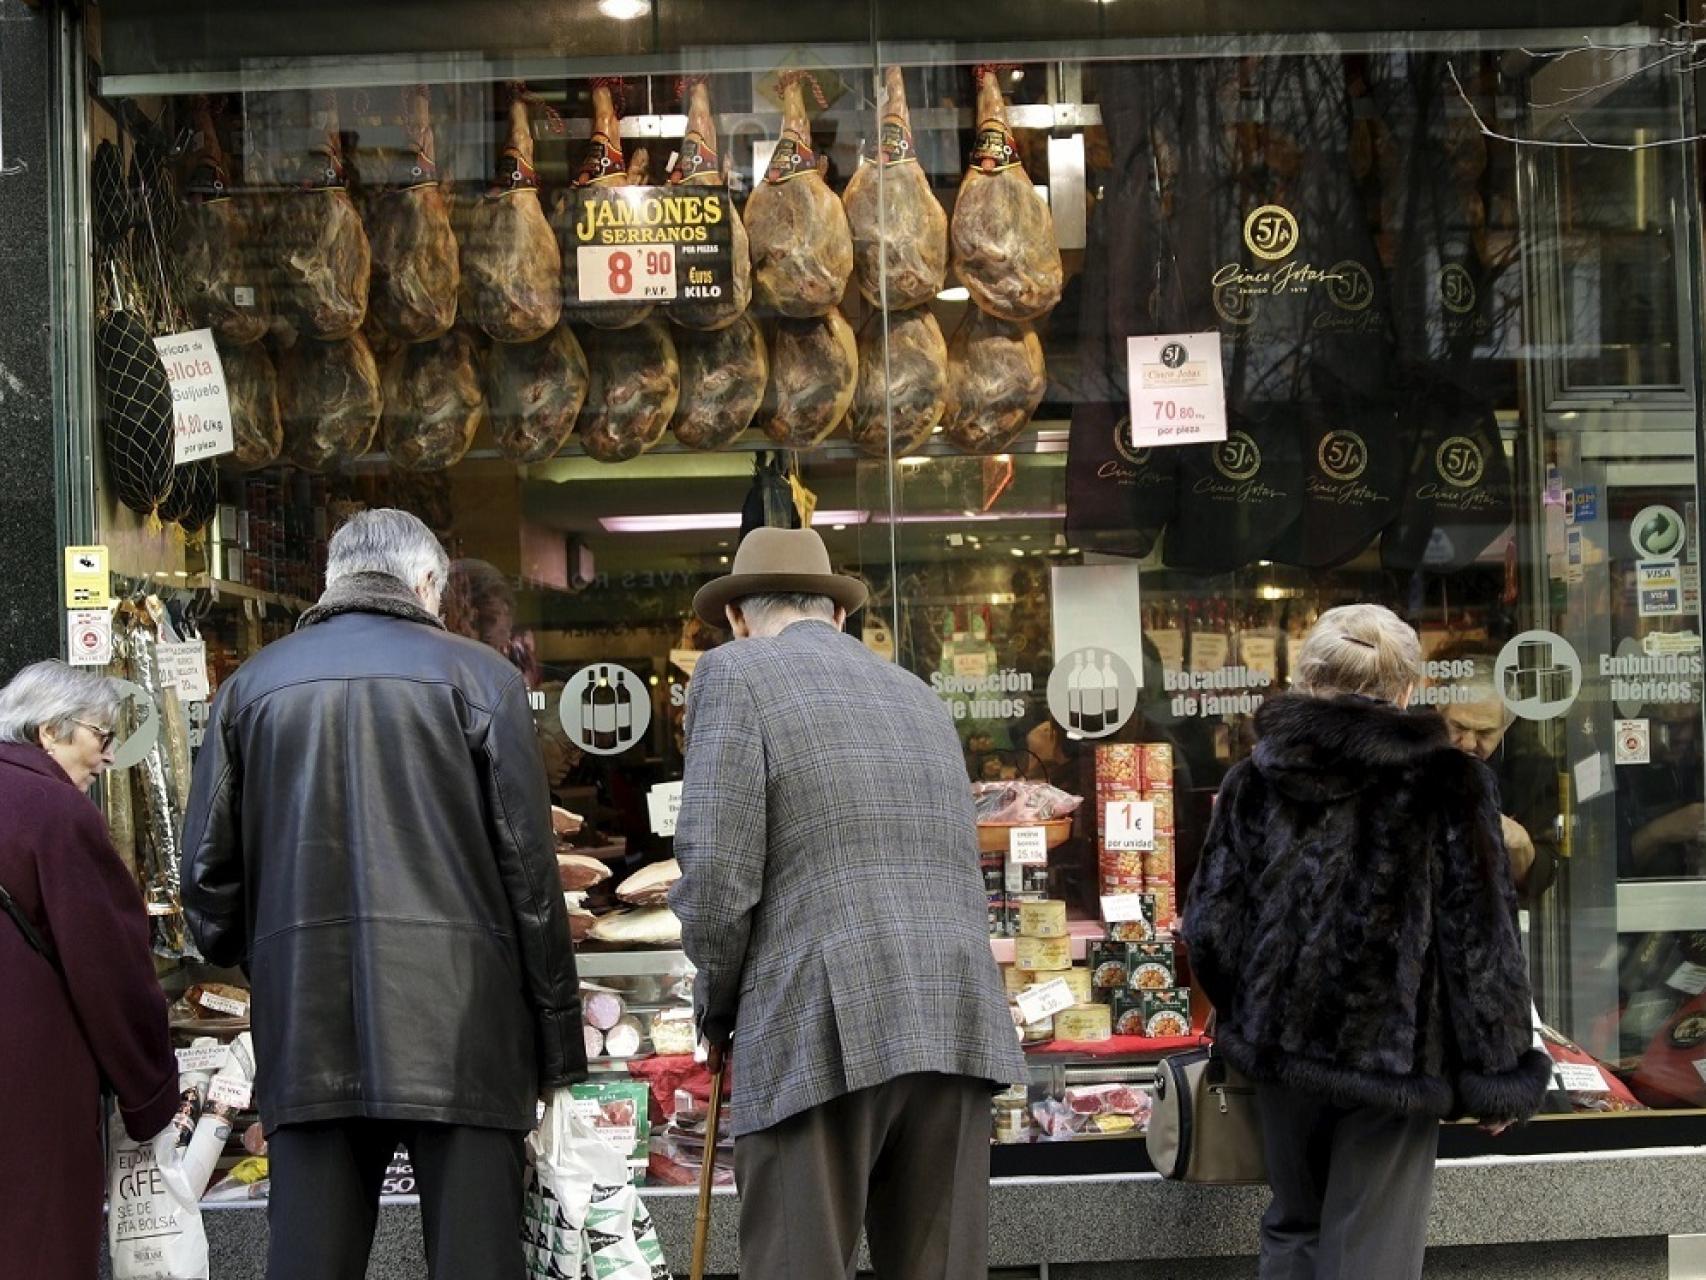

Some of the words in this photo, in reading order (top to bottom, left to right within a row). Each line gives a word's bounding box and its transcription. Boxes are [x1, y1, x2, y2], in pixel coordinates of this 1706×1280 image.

[577, 195, 722, 240] JAMONES
[602, 226, 707, 244] SERRANOS
[1211, 263, 1271, 287] Cinco
[1271, 261, 1343, 295] Jotas
[684, 286, 722, 298] KILO
[166, 359, 213, 382] ellota
[1157, 428, 1174, 437] por
[1176, 424, 1201, 436] pieza
[1646, 569, 1671, 580] VISA
[1650, 591, 1669, 600] VISA
[1163, 665, 1271, 691] Bocadillos
[1408, 683, 1480, 705] electos
[1611, 677, 1692, 702] ibéricos
[967, 697, 1025, 719] vinos
[1171, 693, 1198, 717] de
[1200, 689, 1266, 718] jamón
[1121, 803, 1132, 830] 1
[1134, 818, 1142, 830] €
[1107, 840, 1122, 848] por
[1123, 838, 1153, 849] unidad
[136, 1200, 152, 1216] DE
[139, 1214, 177, 1232] BOLSA
